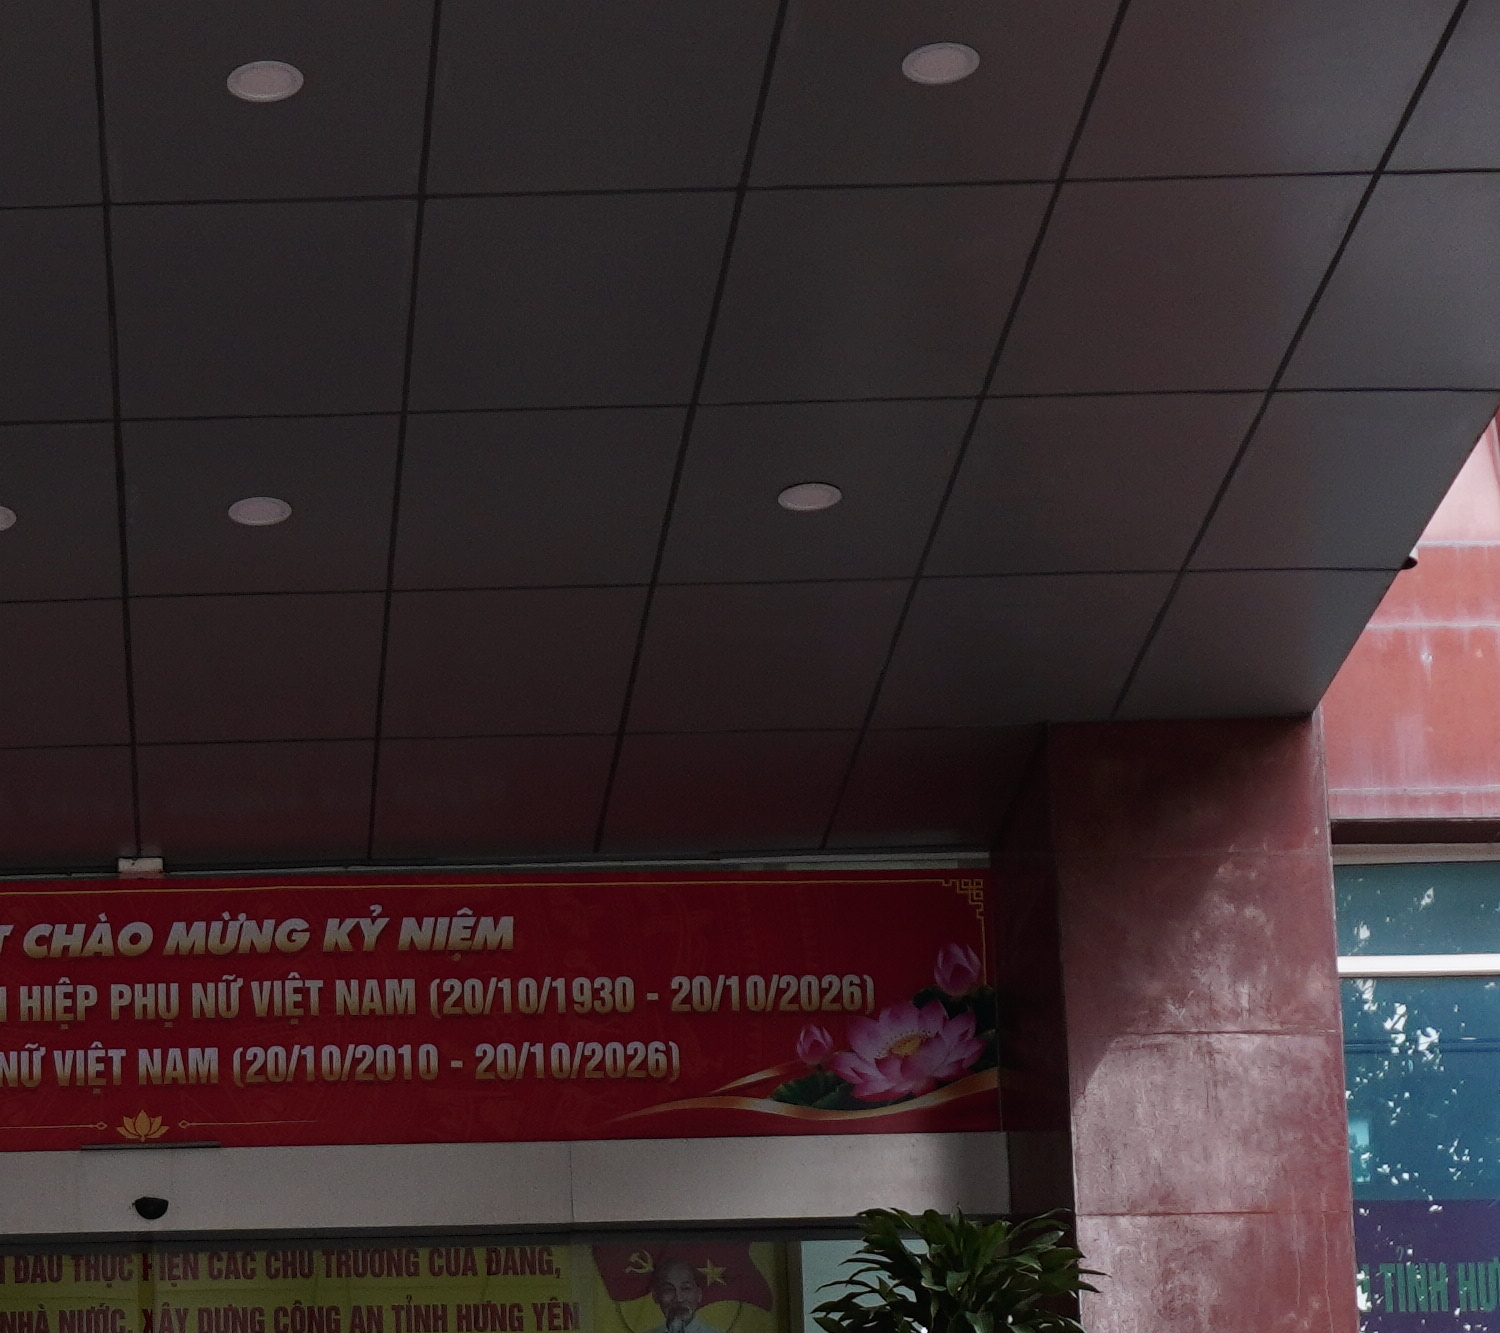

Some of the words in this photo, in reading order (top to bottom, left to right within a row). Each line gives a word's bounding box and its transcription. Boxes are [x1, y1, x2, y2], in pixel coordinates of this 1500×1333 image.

[22, 913, 154, 959] CHÀO
[162, 912, 311, 957] MỪNG
[322, 904, 389, 952] KỶ
[397, 907, 515, 962] NIỆM
[18, 977, 98, 1030] HIỆP
[110, 982, 179, 1028] PHỤ
[191, 975, 241, 1019] NỮ
[251, 972, 324, 1025] VIỆT
[334, 979, 417, 1016] NAM
[429, 976, 635, 1019] (20/10/1930
[646, 992, 660, 1001] -
[671, 974, 875, 1015] 20/10/2026)
[53, 1041, 126, 1093] VIỆT
[137, 1047, 219, 1084] NAM
[232, 1043, 439, 1087] (20/10/2010
[450, 1059, 464, 1069] -
[474, 1041, 680, 1082] 20/10/2026)
[1380, 1246, 1449, 1312] TỈNH
[349, 1304, 385, 1333] AN
[392, 1295, 448, 1333] TỈNH
[456, 1301, 523, 1333] HƯNG
[532, 1296, 581, 1331] YÊN
